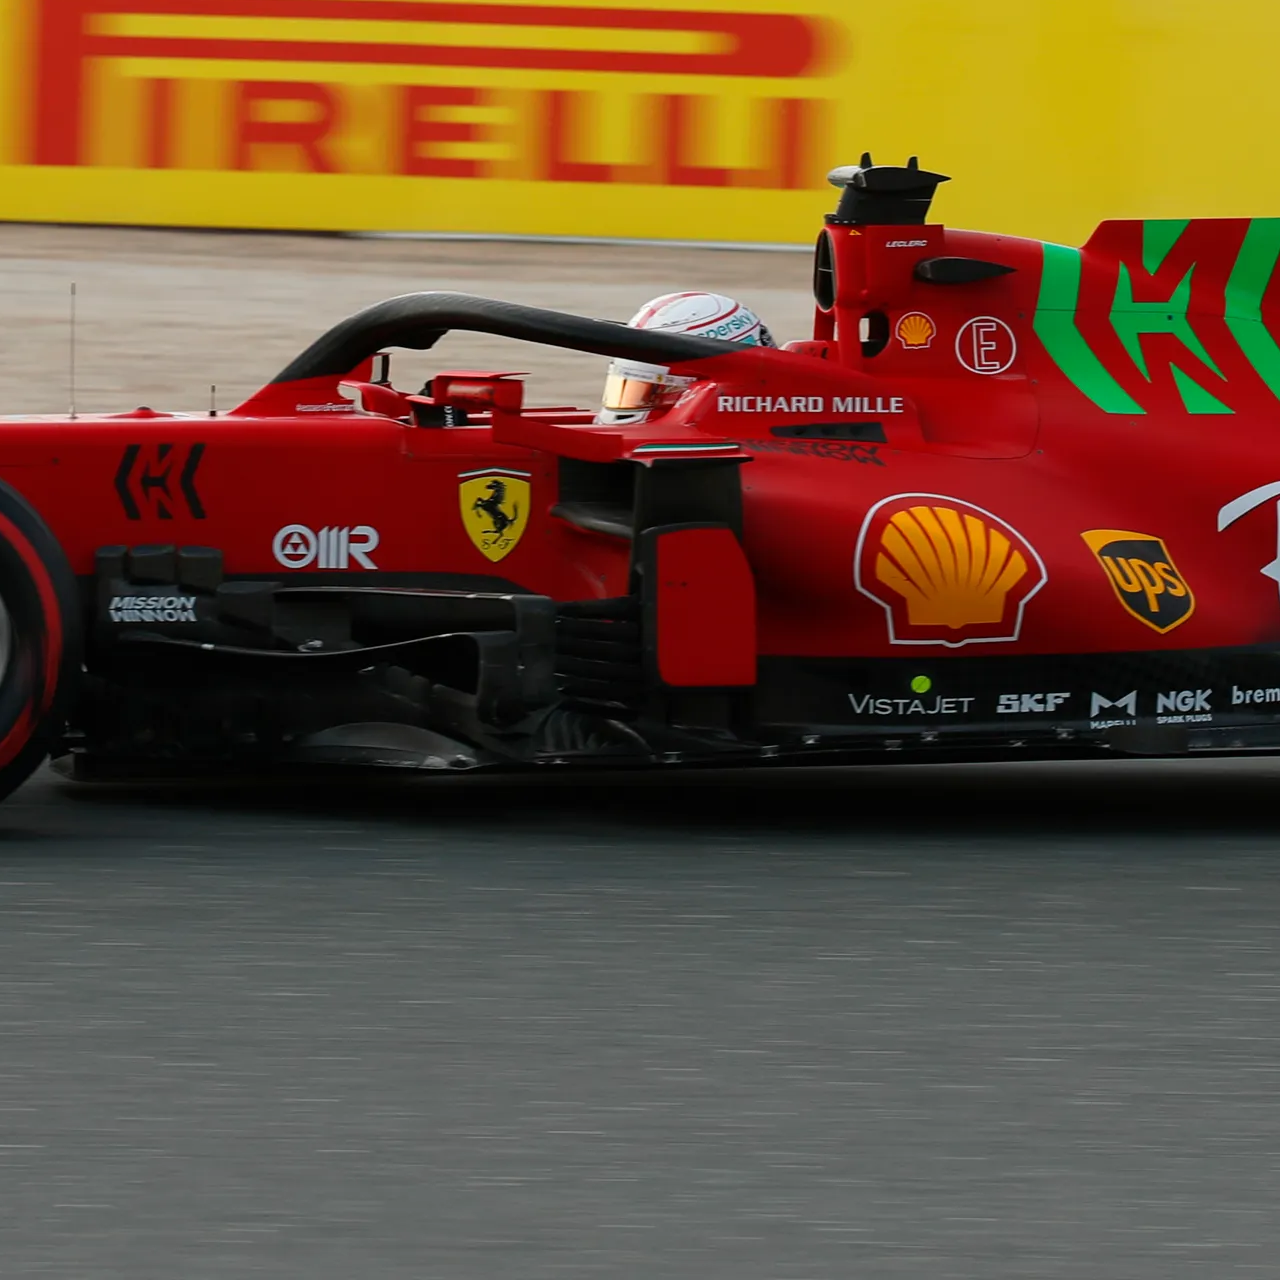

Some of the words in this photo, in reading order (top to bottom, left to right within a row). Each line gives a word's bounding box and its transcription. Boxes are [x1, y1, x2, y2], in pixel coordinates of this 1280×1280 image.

[885, 239, 928, 248] LECLERC
[717, 396, 825, 413] RICHARD
[832, 397, 904, 413] MILLE
[1100, 555, 1186, 613] ups
[109, 596, 197, 609] MISSION
[996, 692, 1071, 713] SKF
[1156, 688, 1213, 713] NGK
[1156, 716, 1185, 724] SPARK
[1186, 714, 1212, 722] PLUGS
